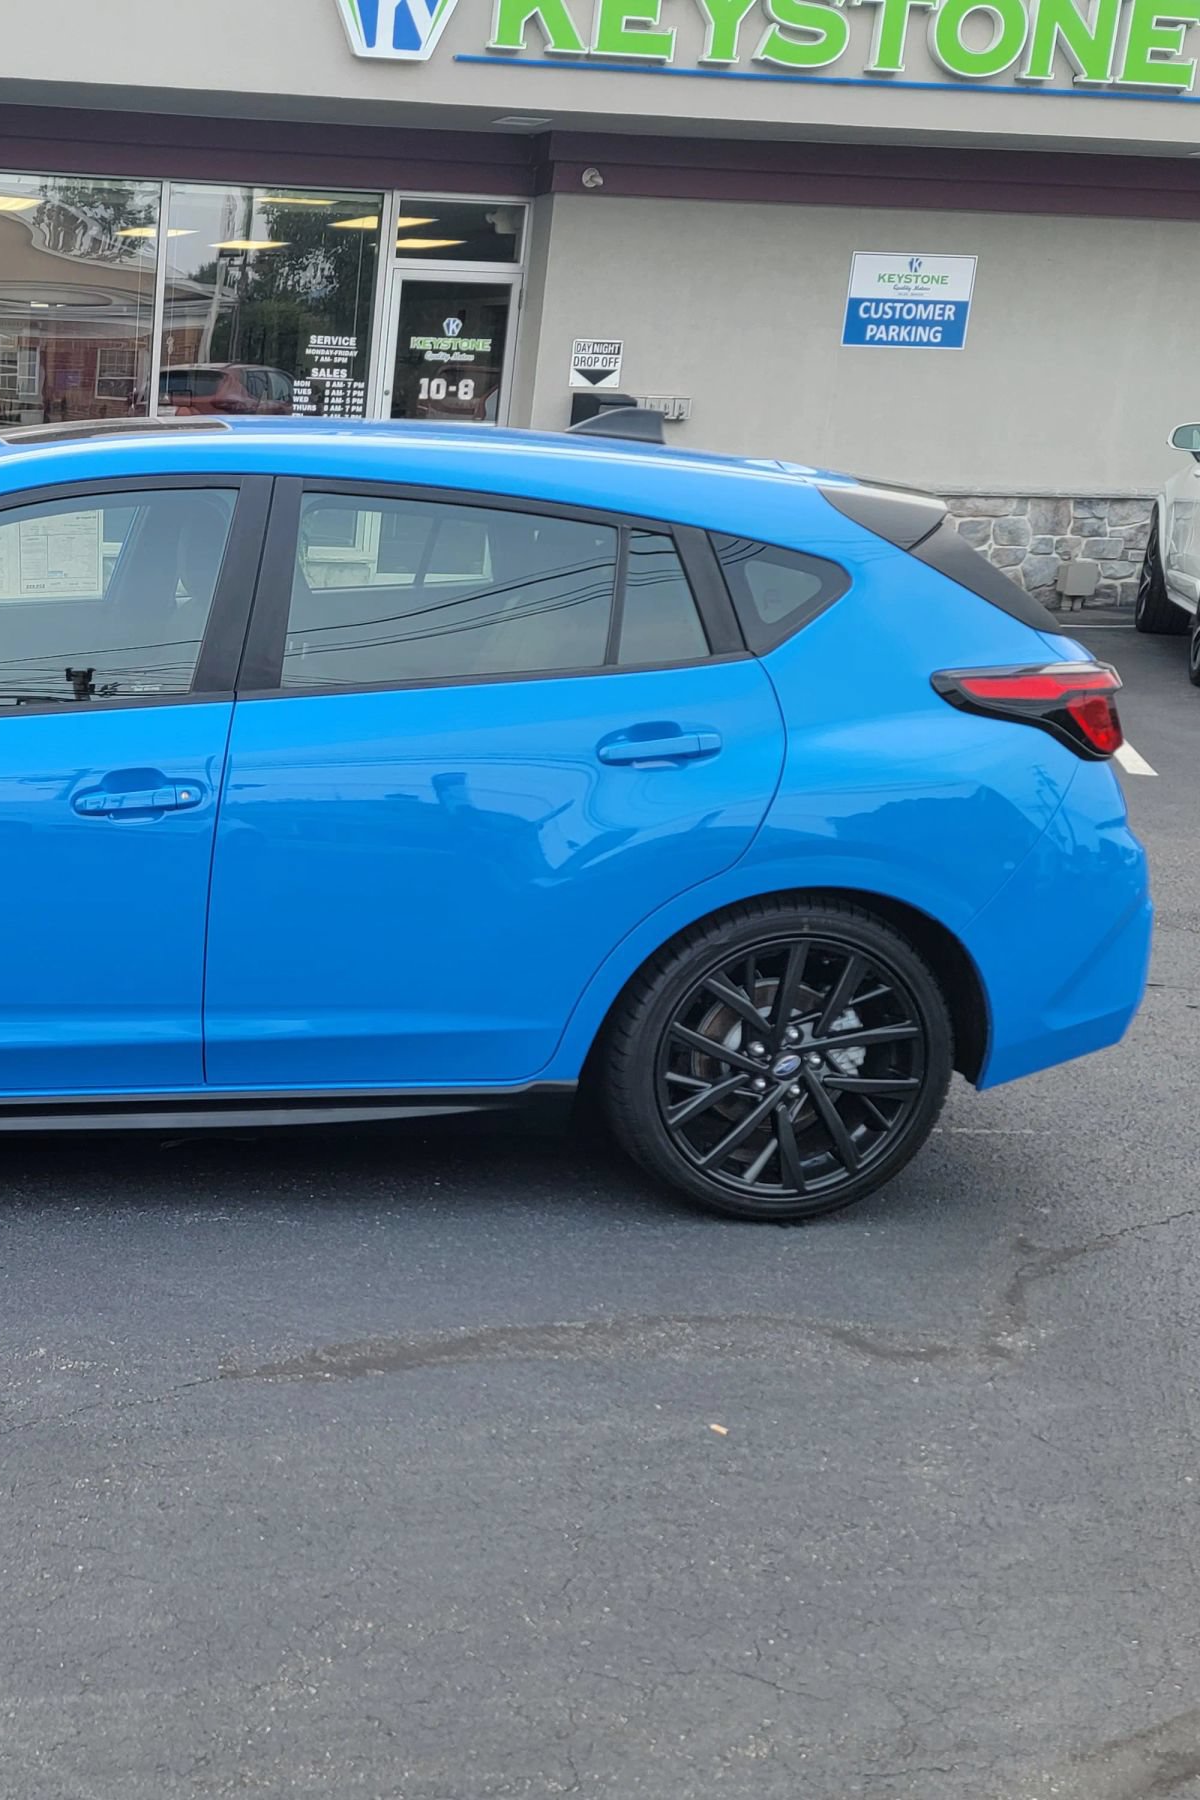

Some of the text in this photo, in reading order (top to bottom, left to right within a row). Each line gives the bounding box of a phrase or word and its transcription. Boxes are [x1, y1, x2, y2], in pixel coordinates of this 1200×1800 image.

[487, 0, 1200, 91] KEYSTONE
[877, 272, 949, 285] KEYSTONE
[859, 301, 956, 321] CUSTOMER
[865, 324, 943, 343] PARKING
[310, 334, 357, 346] SERVICE
[410, 336, 492, 352] KEYSTONE
[305, 348, 358, 357] MONDAY-FRIDAY
[576, 342, 620, 354] DAY NIGHT
[573, 356, 620, 368] DROP OFF
[311, 367, 348, 378] SALES
[419, 378, 475, 400] 10-8
[352, 397, 363, 405] PM
